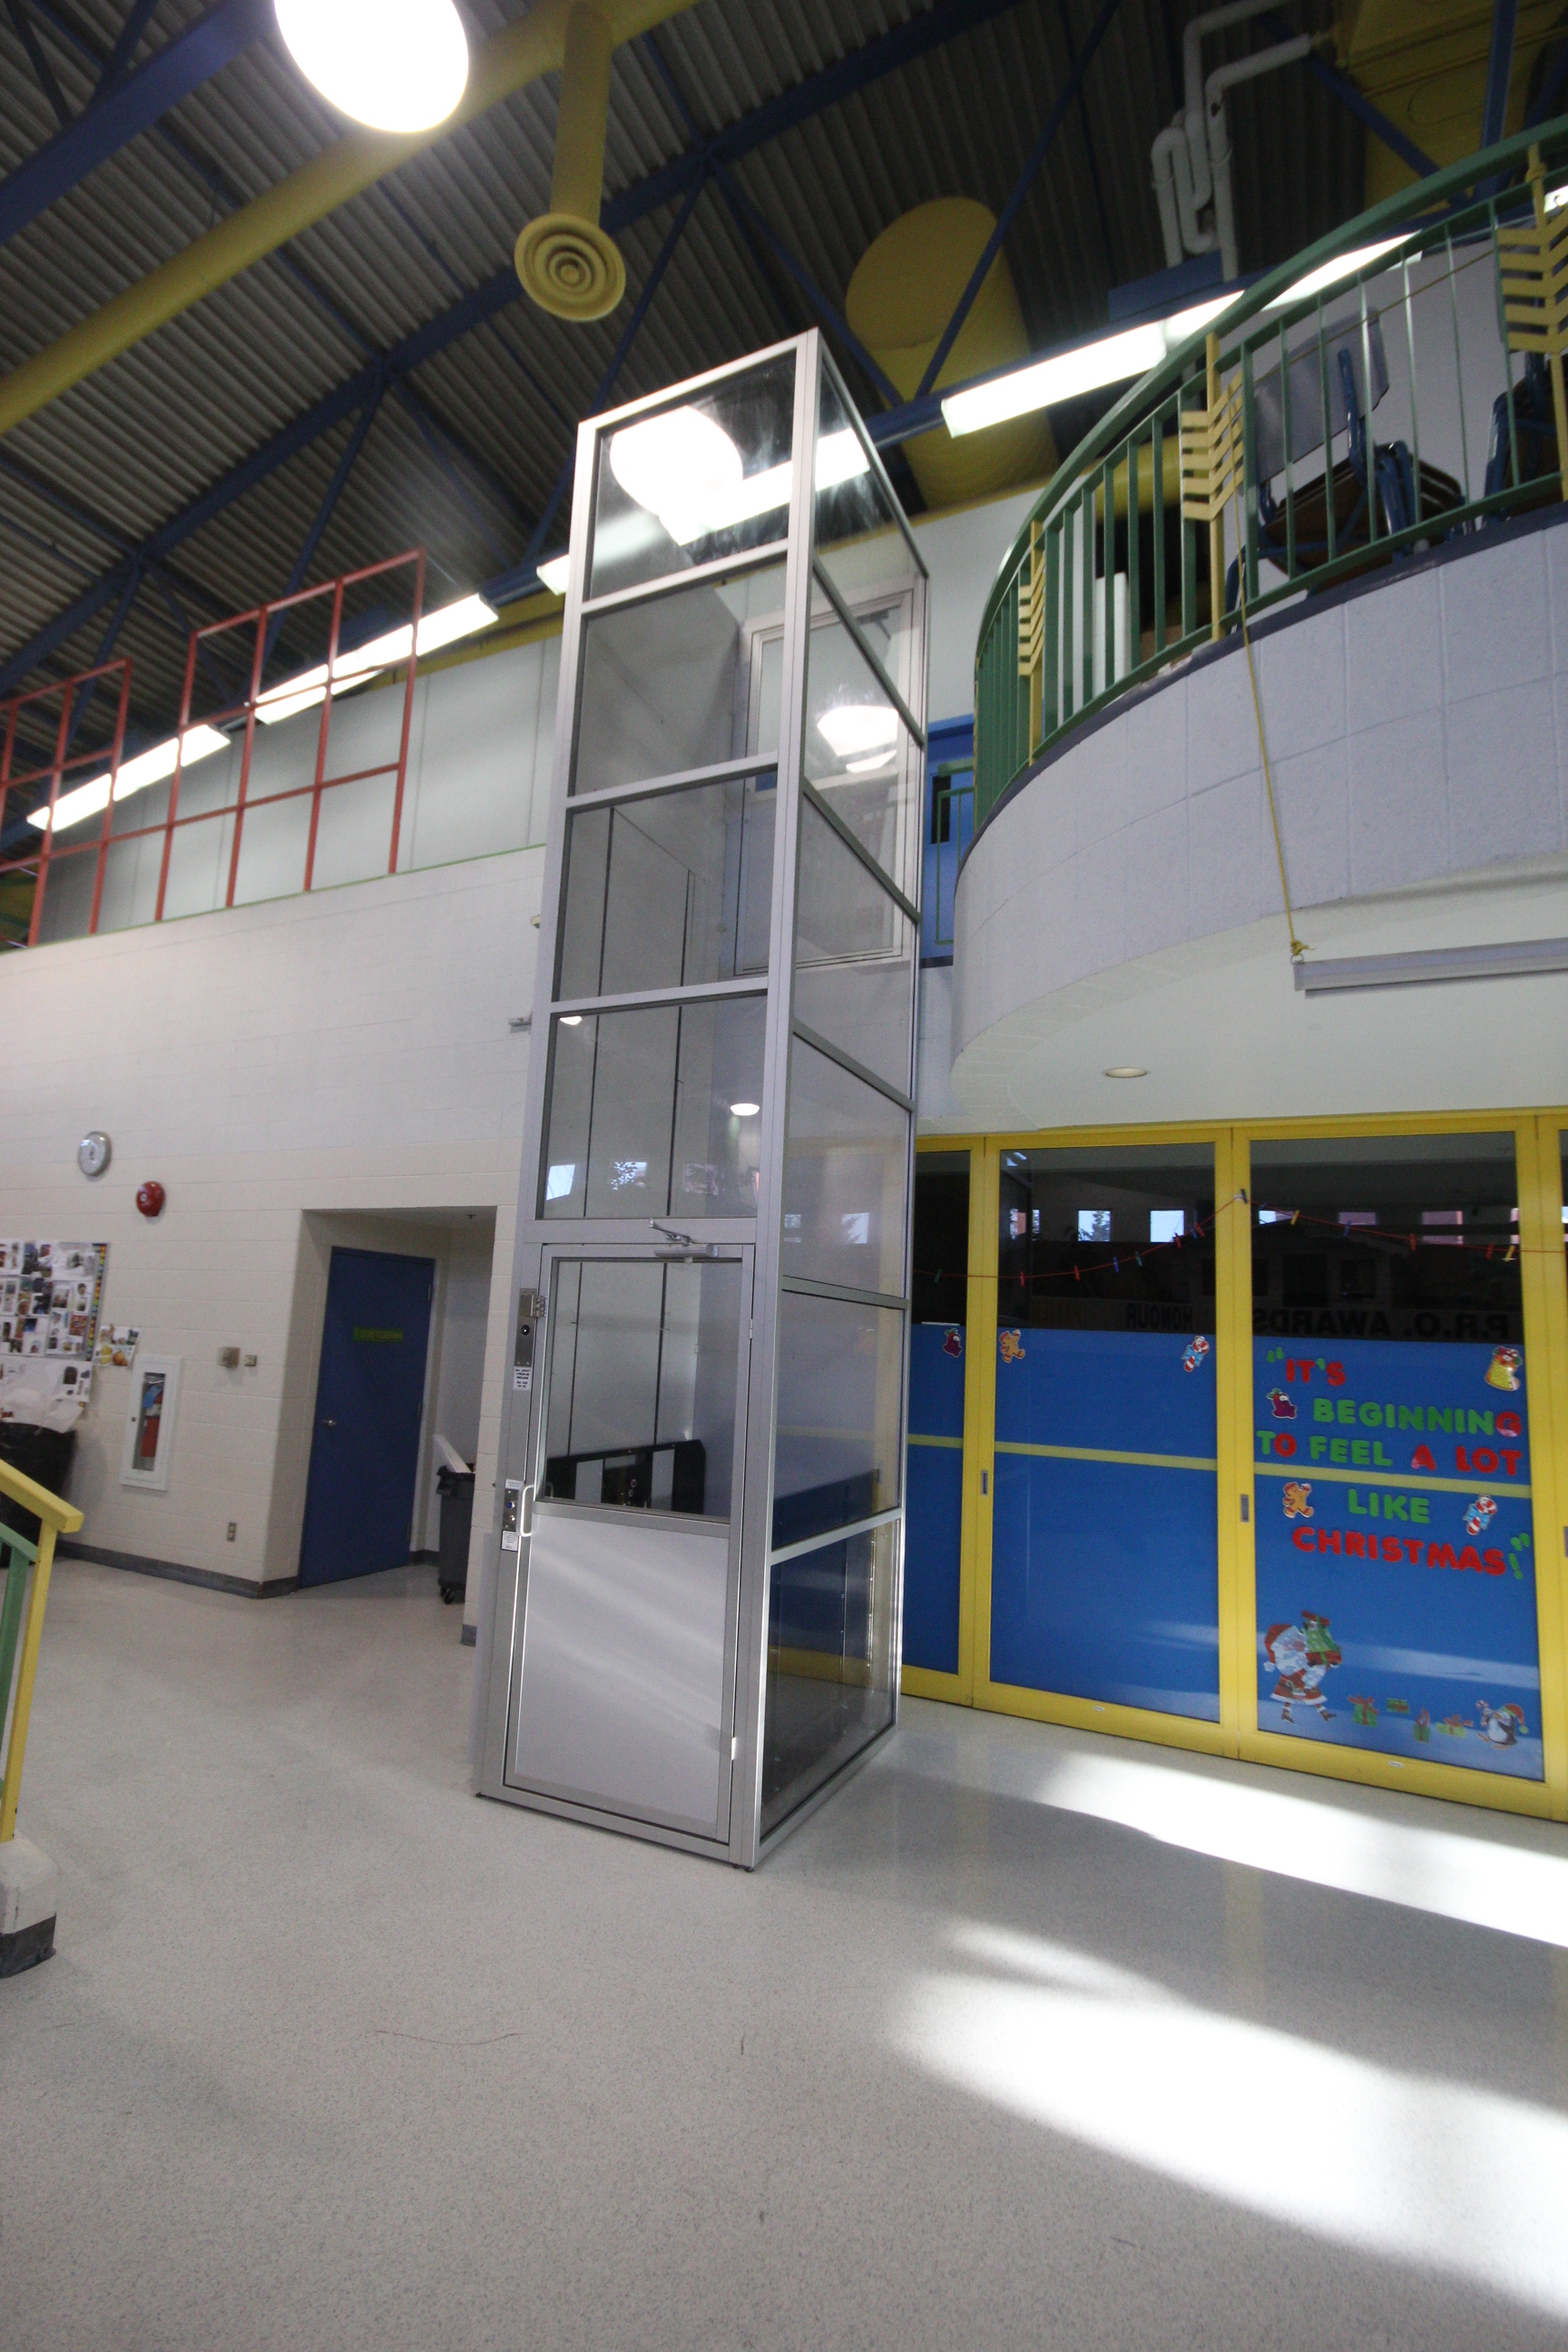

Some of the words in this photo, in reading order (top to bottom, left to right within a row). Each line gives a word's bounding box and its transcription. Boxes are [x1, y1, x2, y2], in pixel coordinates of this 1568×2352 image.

[1313, 1397, 1523, 1437] BEGINNING
[1257, 1430, 1297, 1456] TO
[1309, 1436, 1393, 1466] FEEL
[1411, 1445, 1436, 1471] A
[1455, 1446, 1523, 1475] LOT
[1348, 1488, 1430, 1524] LIKE
